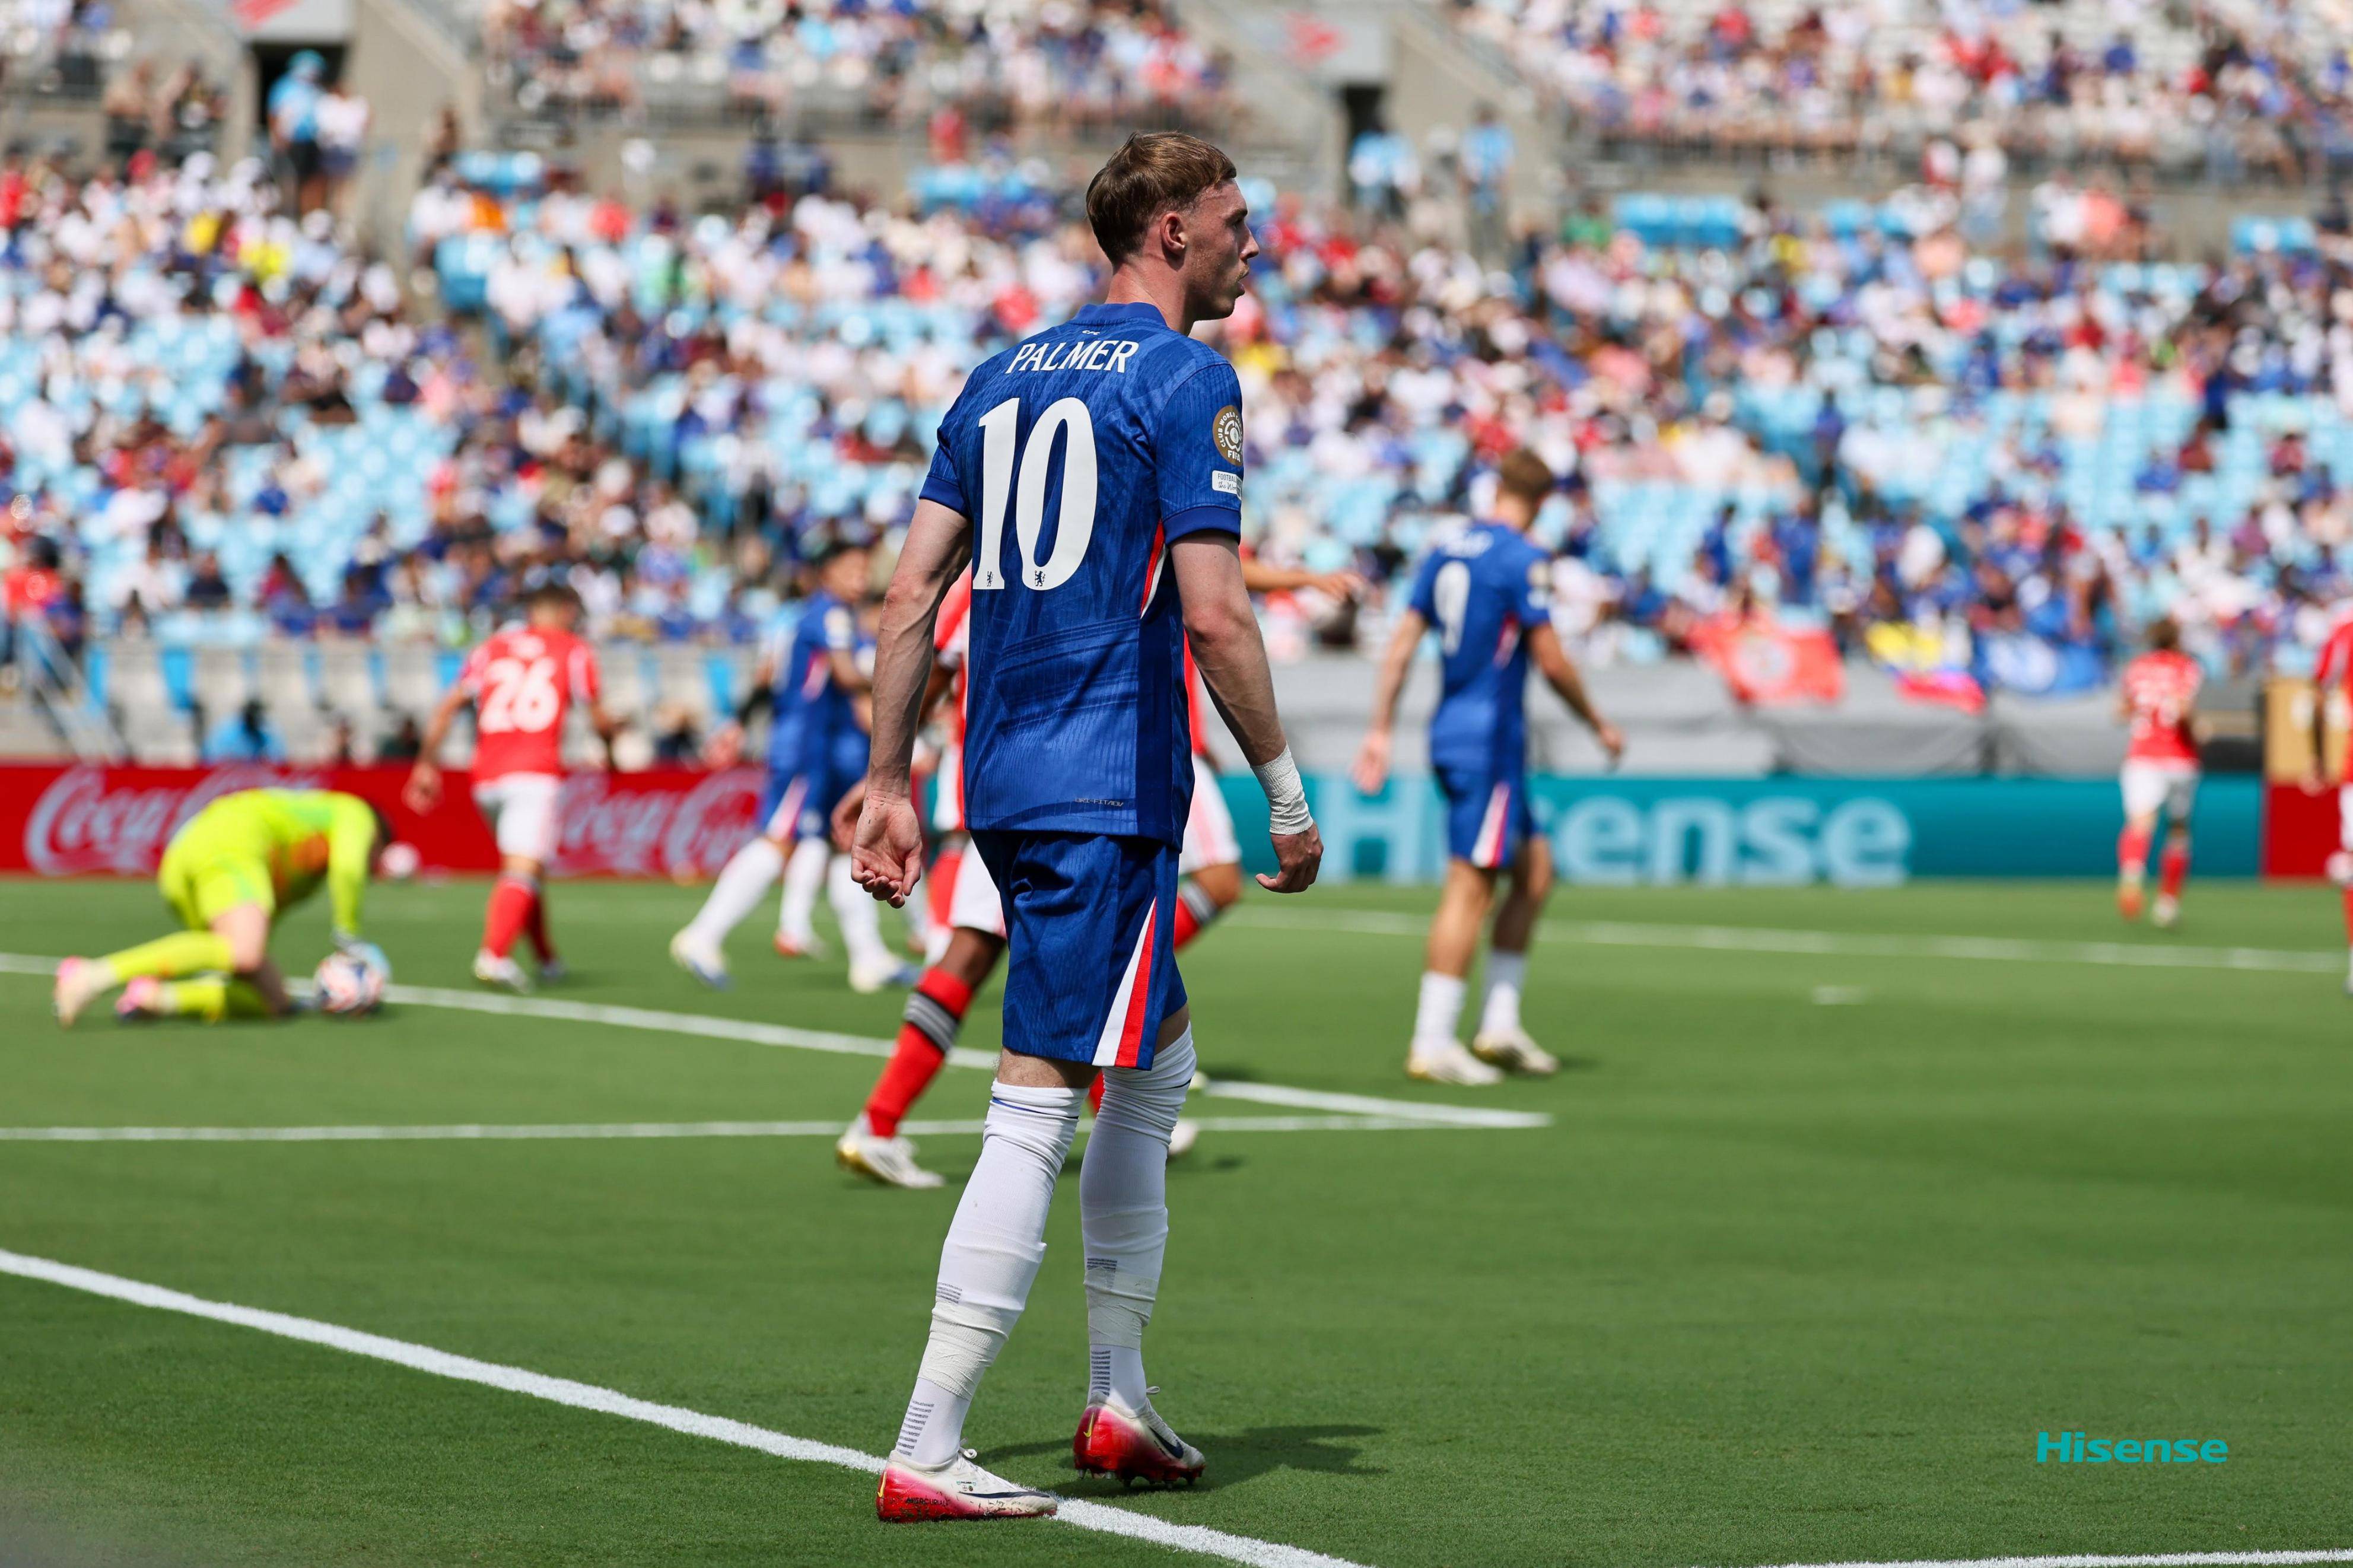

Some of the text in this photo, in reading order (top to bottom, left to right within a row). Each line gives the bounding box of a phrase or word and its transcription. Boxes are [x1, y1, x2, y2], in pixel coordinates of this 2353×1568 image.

[1005, 340, 1139, 374] PALMER
[1217, 427, 1226, 448] CLUB
[1219, 411, 1236, 427] WORLD
[1228, 450, 1241, 462] FIFA
[972, 397, 1098, 591] 10
[1433, 559, 1471, 656] 9
[478, 656, 559, 733] 26
[1318, 778, 1912, 888] Hiense
